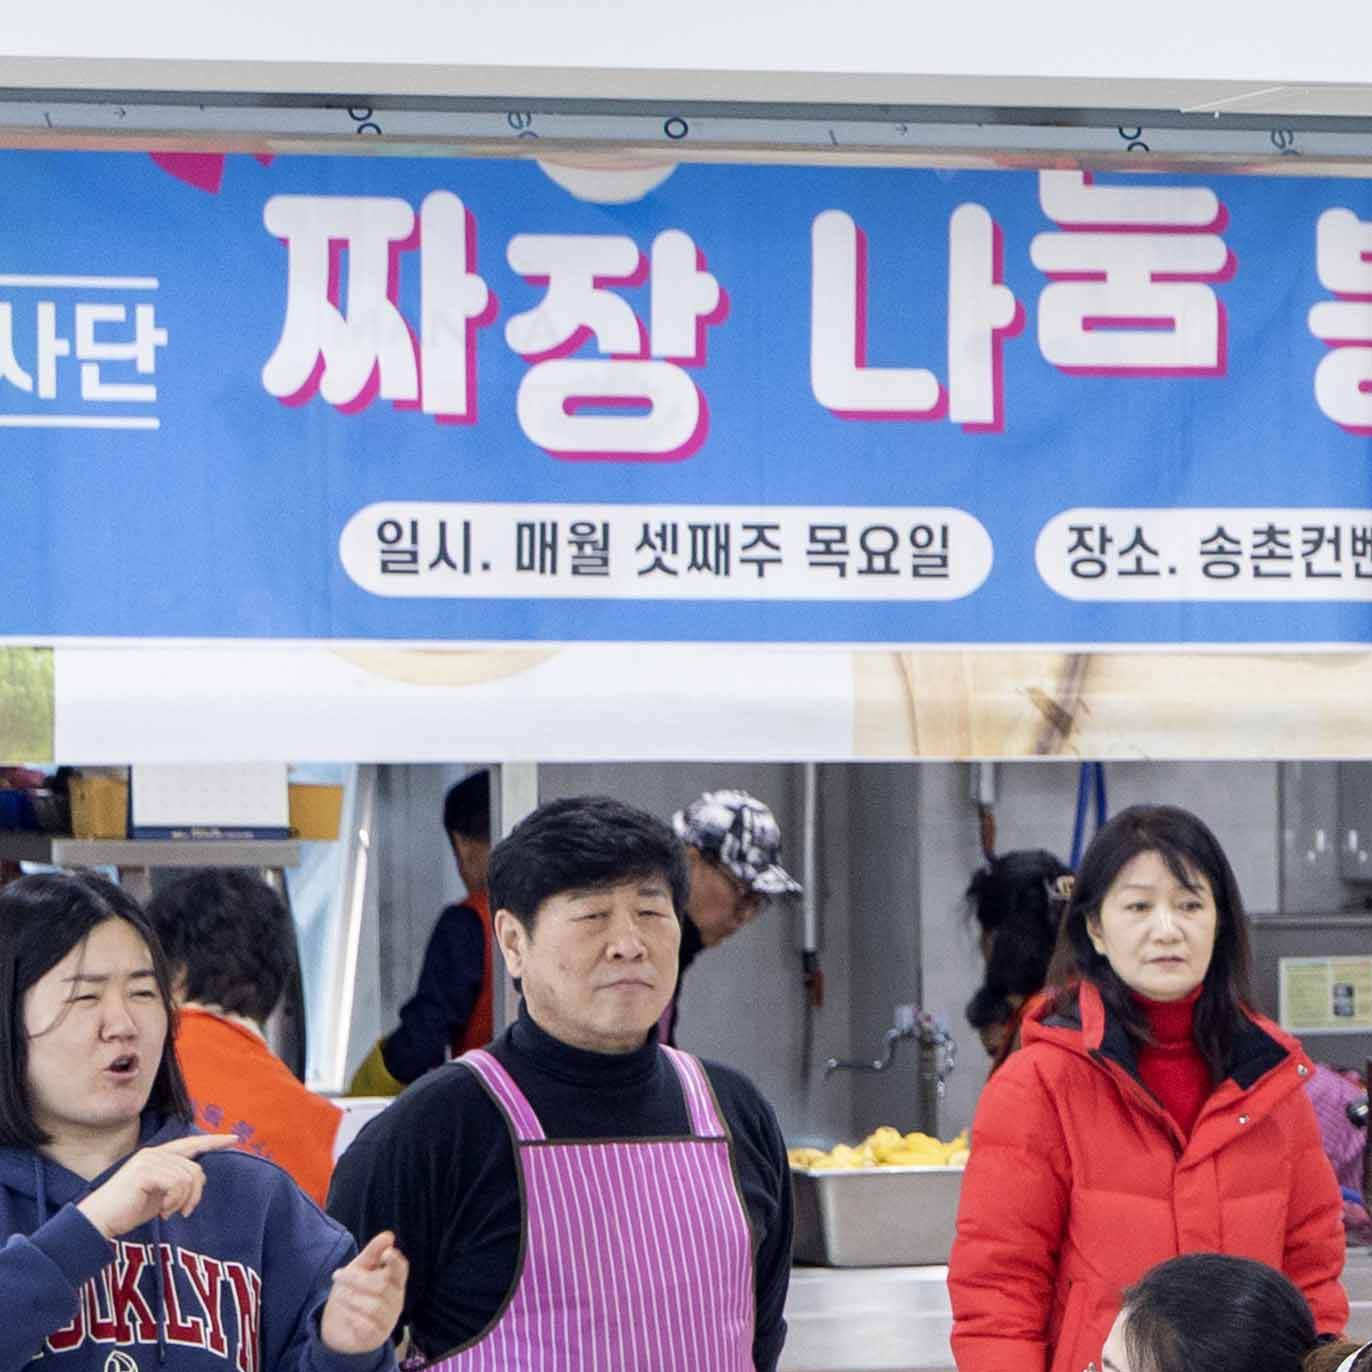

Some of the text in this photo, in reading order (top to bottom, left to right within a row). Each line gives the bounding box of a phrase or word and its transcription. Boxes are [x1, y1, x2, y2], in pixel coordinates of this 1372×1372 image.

[262, 190, 731, 463] 짜장
[811, 169, 1237, 433] 나눔
[376, 519, 952, 580] 일시. 매월 셋째주 목요일
[1067, 523, 1178, 581] 장소.
